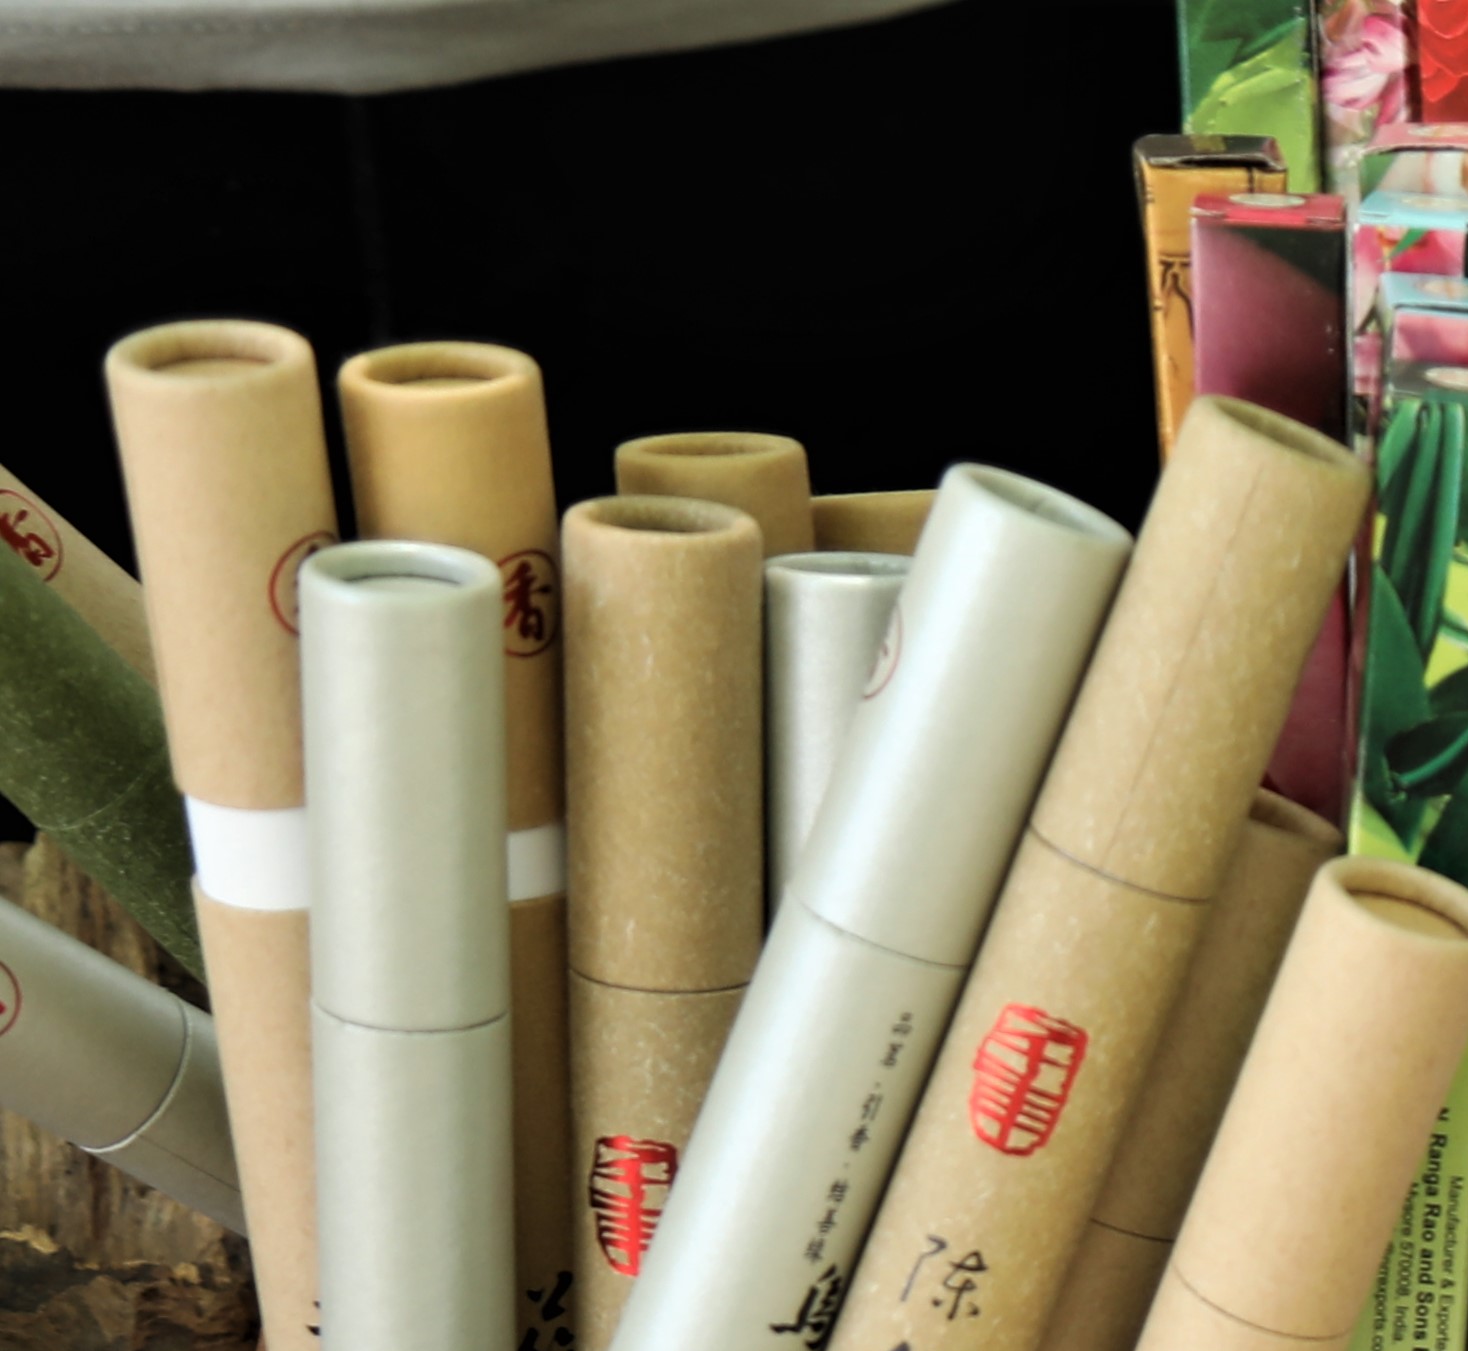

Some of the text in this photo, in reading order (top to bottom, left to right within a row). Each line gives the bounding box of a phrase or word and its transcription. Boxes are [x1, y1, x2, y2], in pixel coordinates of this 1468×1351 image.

[1421, 1133, 1445, 1197] Ranga
[1421, 1203, 1440, 1241] Rao
[1441, 1175, 1464, 1274] Manufacturer
[1418, 1248, 1437, 1286] and
[1440, 1277, 1455, 1289] &
[1413, 1291, 1433, 1339] Sons
